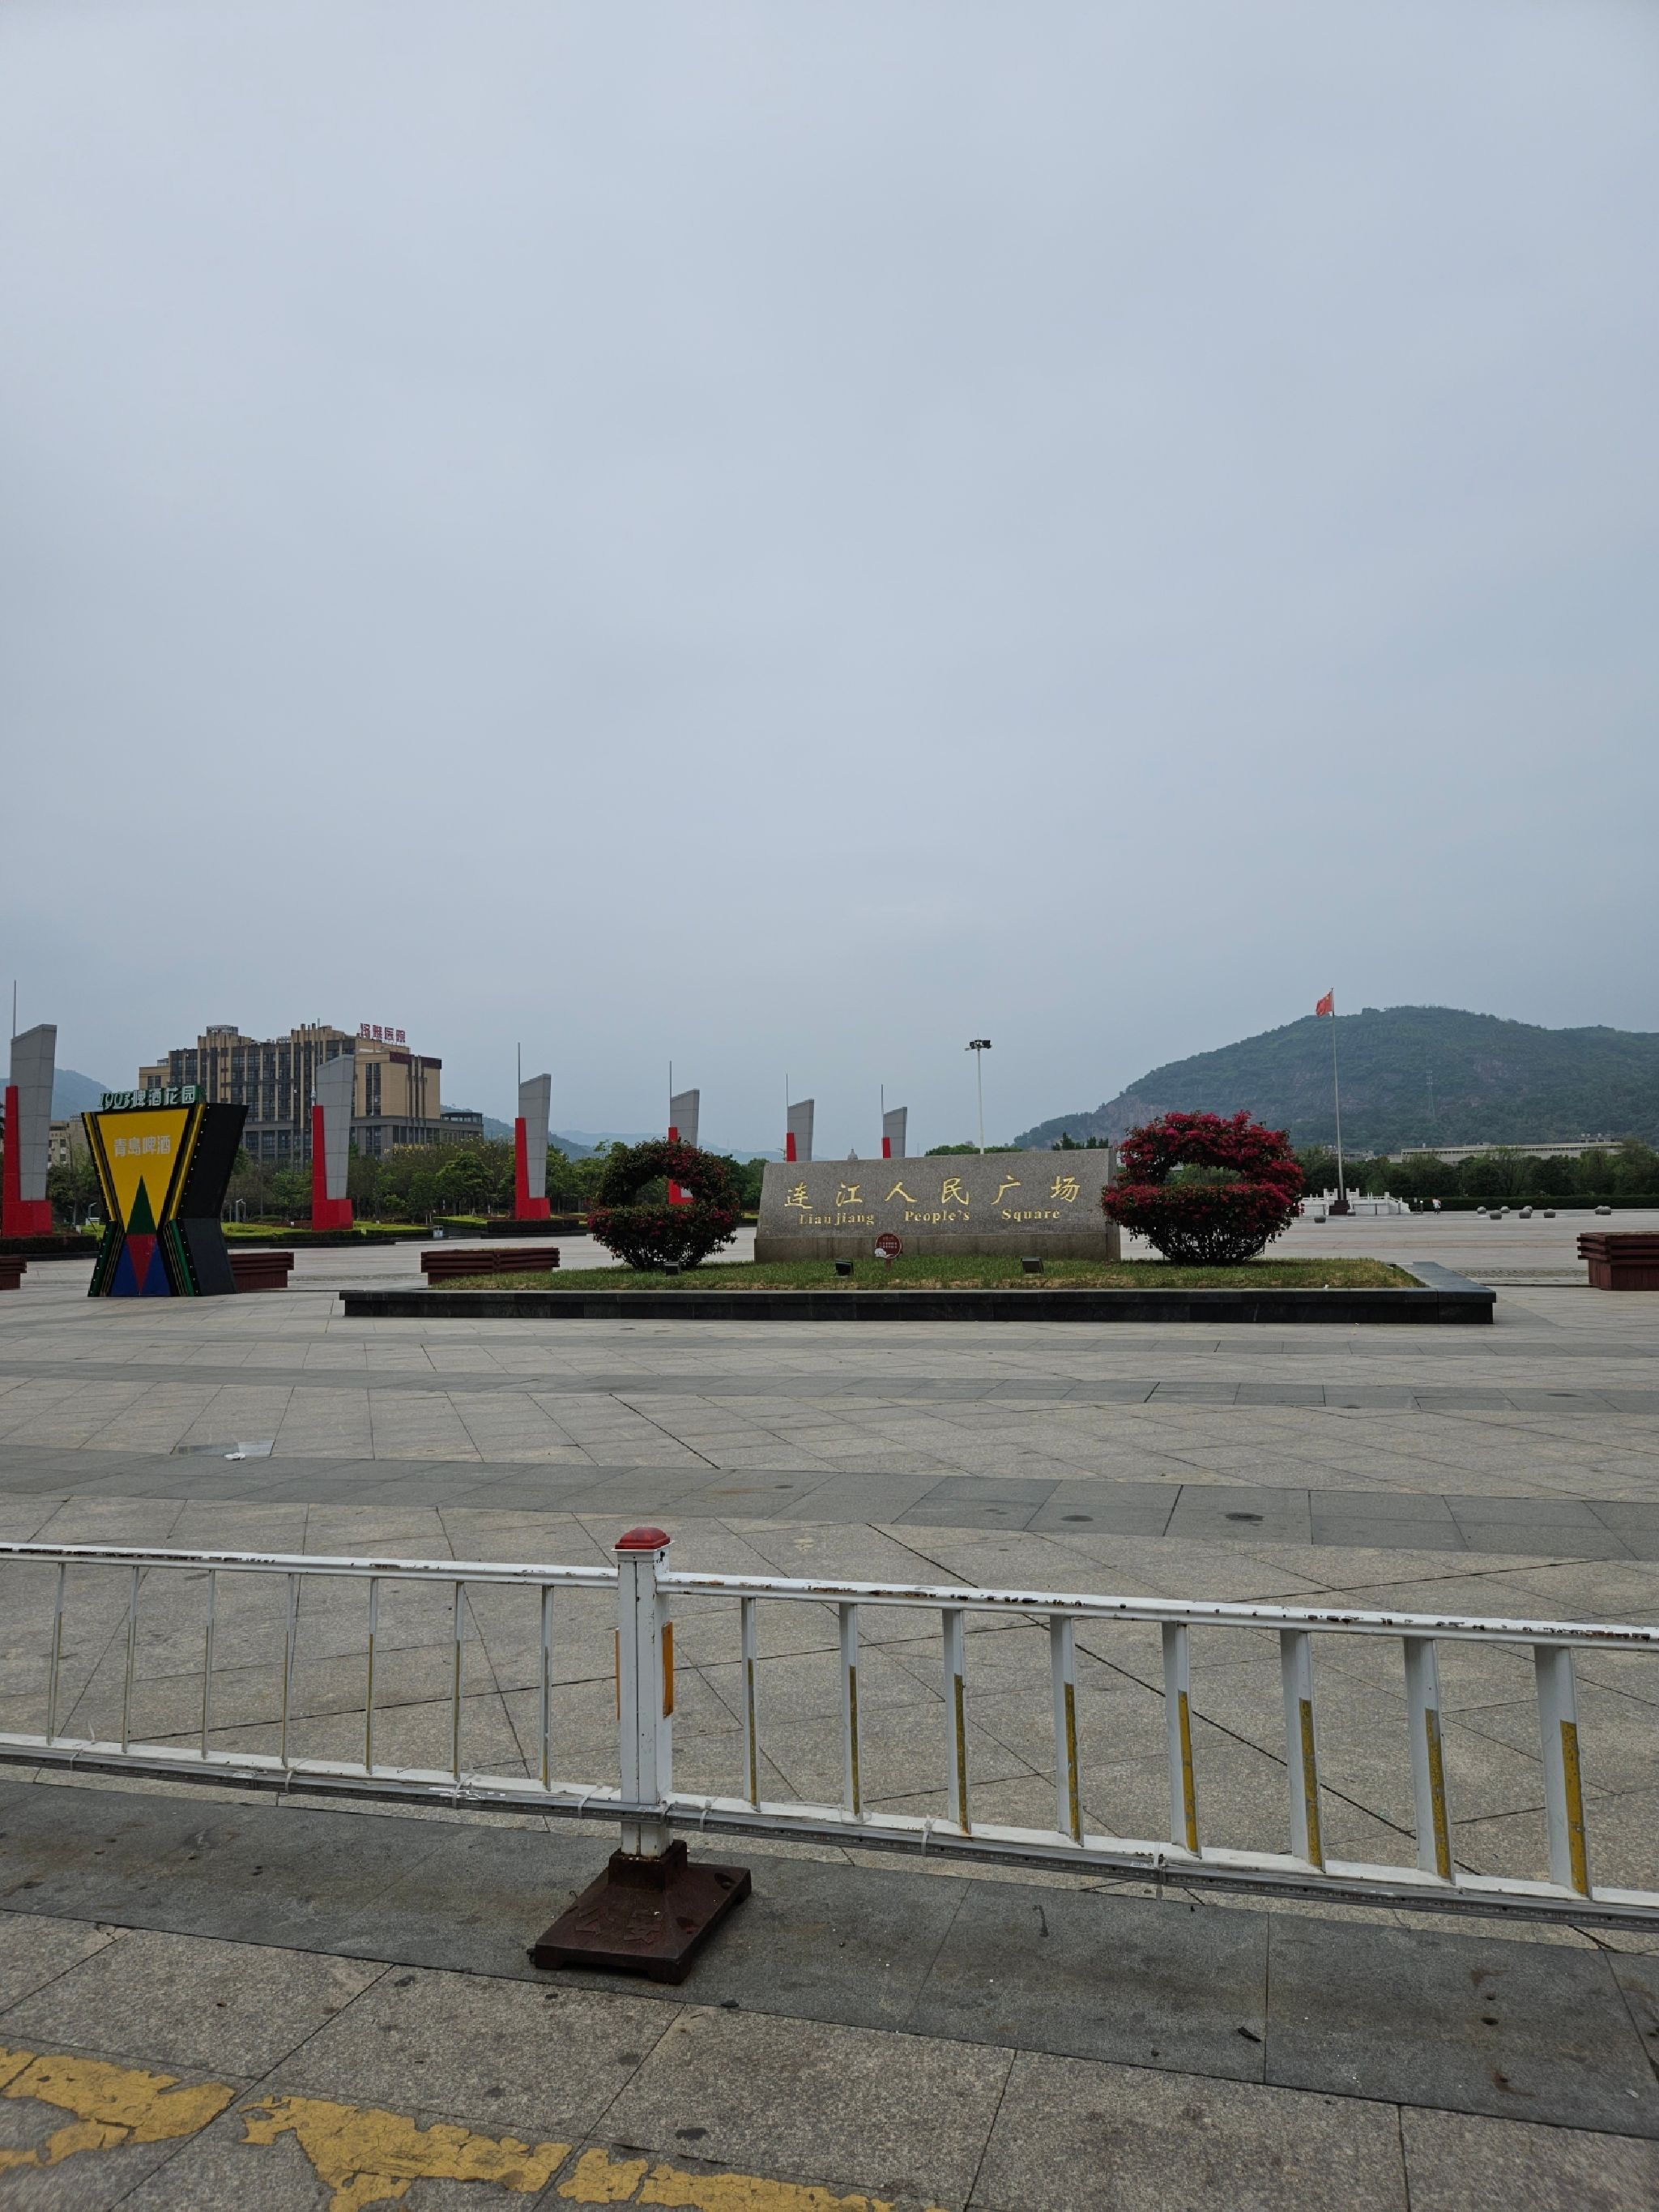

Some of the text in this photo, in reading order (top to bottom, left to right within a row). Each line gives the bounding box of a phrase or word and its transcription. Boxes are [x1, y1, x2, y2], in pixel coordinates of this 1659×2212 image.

[97, 1085, 196, 1110] 1903啤酒花园
[784, 1175, 1081, 1209] 连江人民广场
[904, 1209, 970, 1223] People's
[1001, 1208, 1060, 1221] Square
[575, 1904, 663, 1945] 公安
